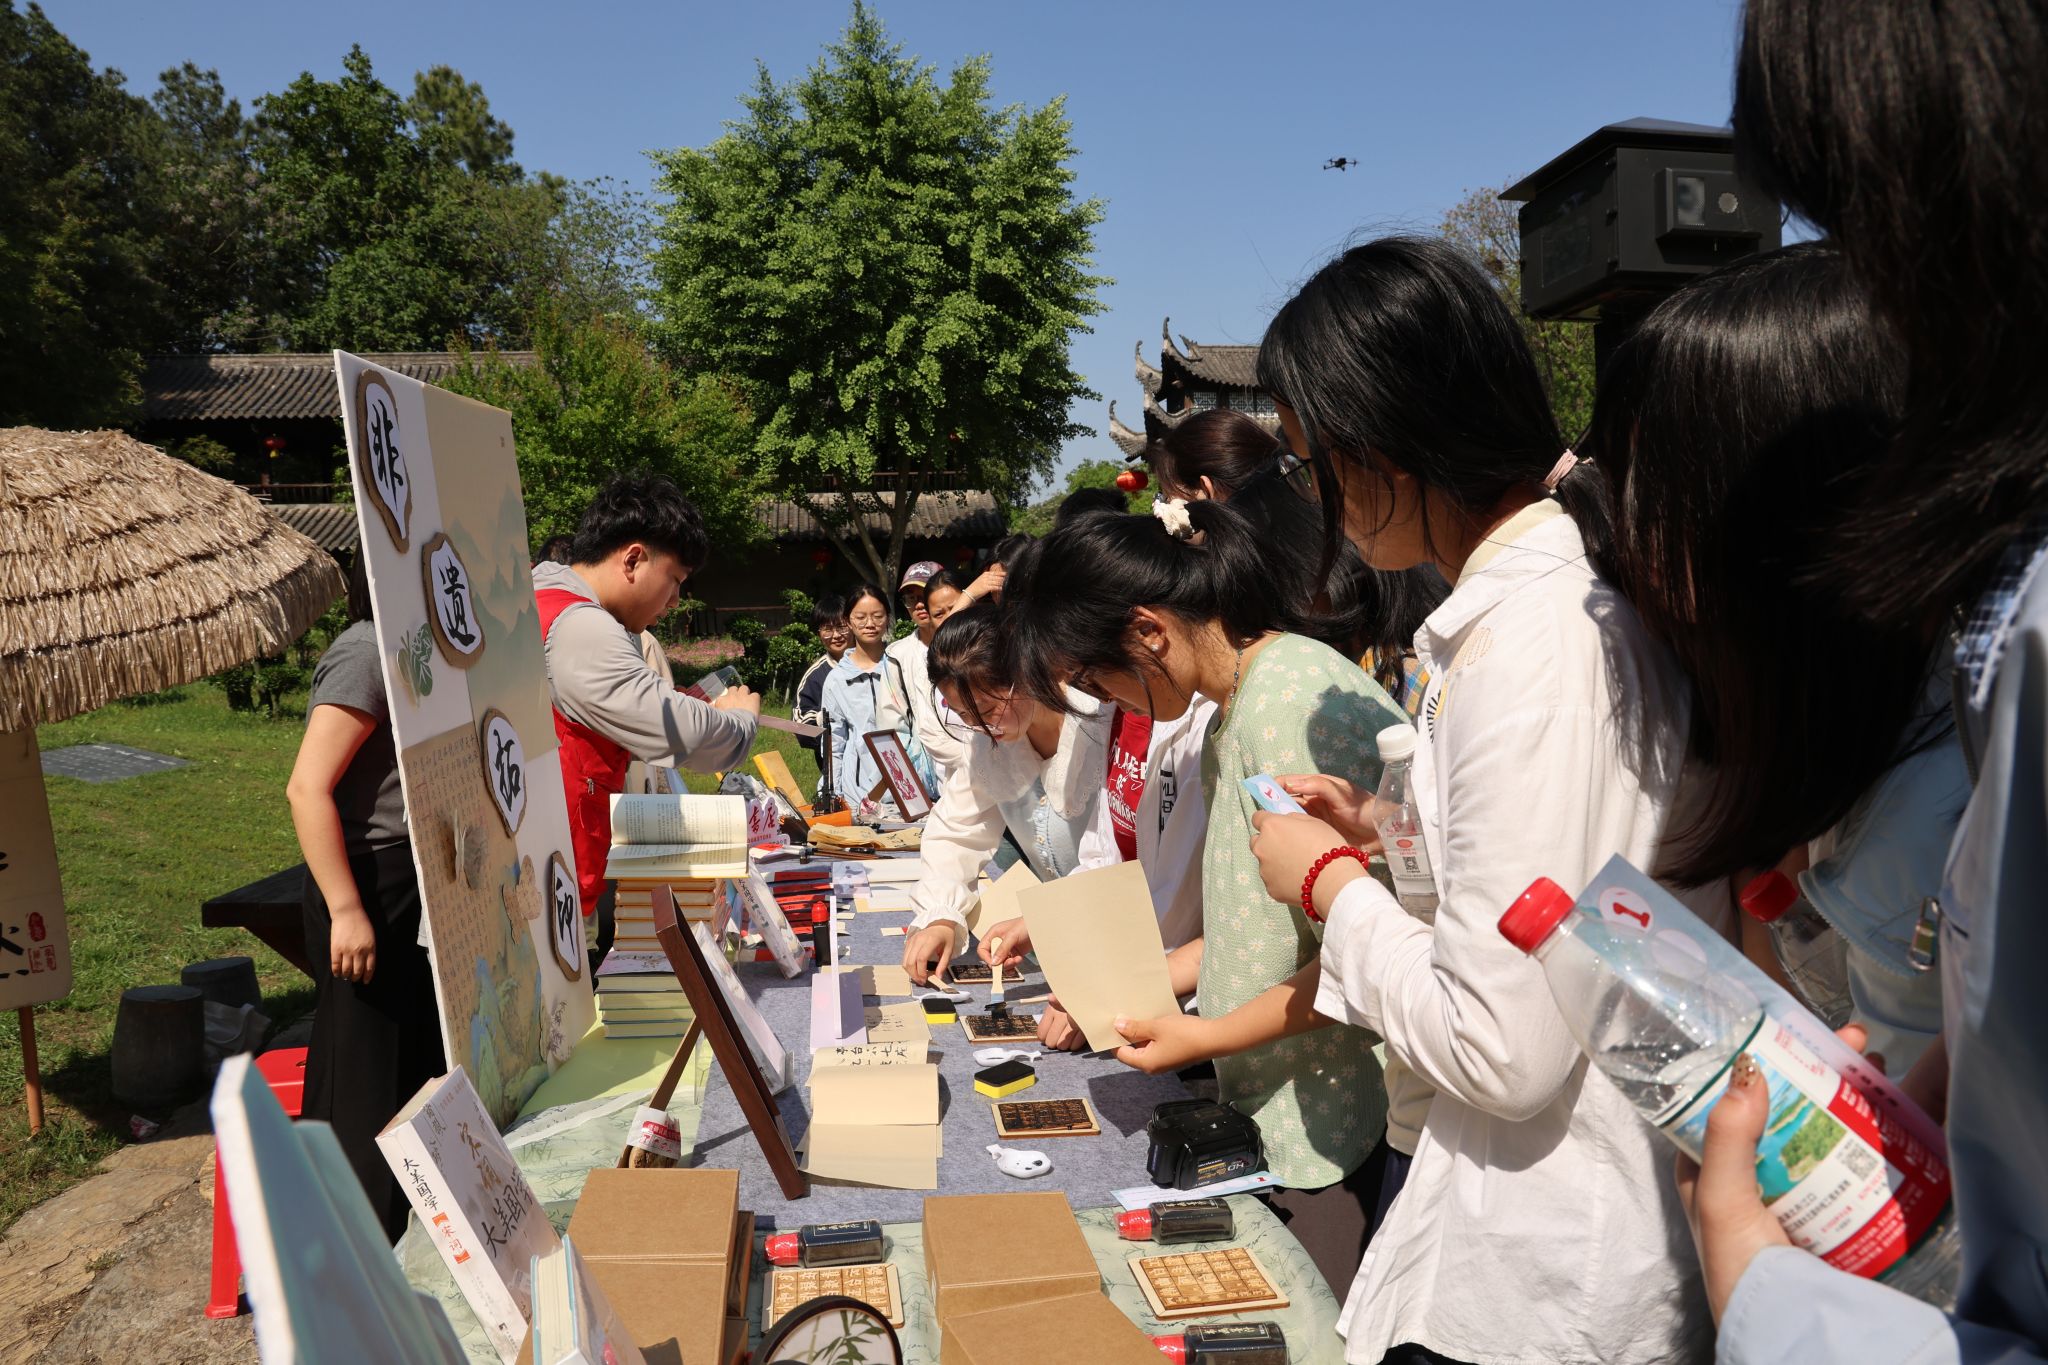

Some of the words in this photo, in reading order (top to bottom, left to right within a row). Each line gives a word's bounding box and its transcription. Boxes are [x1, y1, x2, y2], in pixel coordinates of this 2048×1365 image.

[371, 399, 404, 511] 非
[403, 1157, 438, 1211] 大美国学
[481, 1165, 533, 1258] 大美国学
